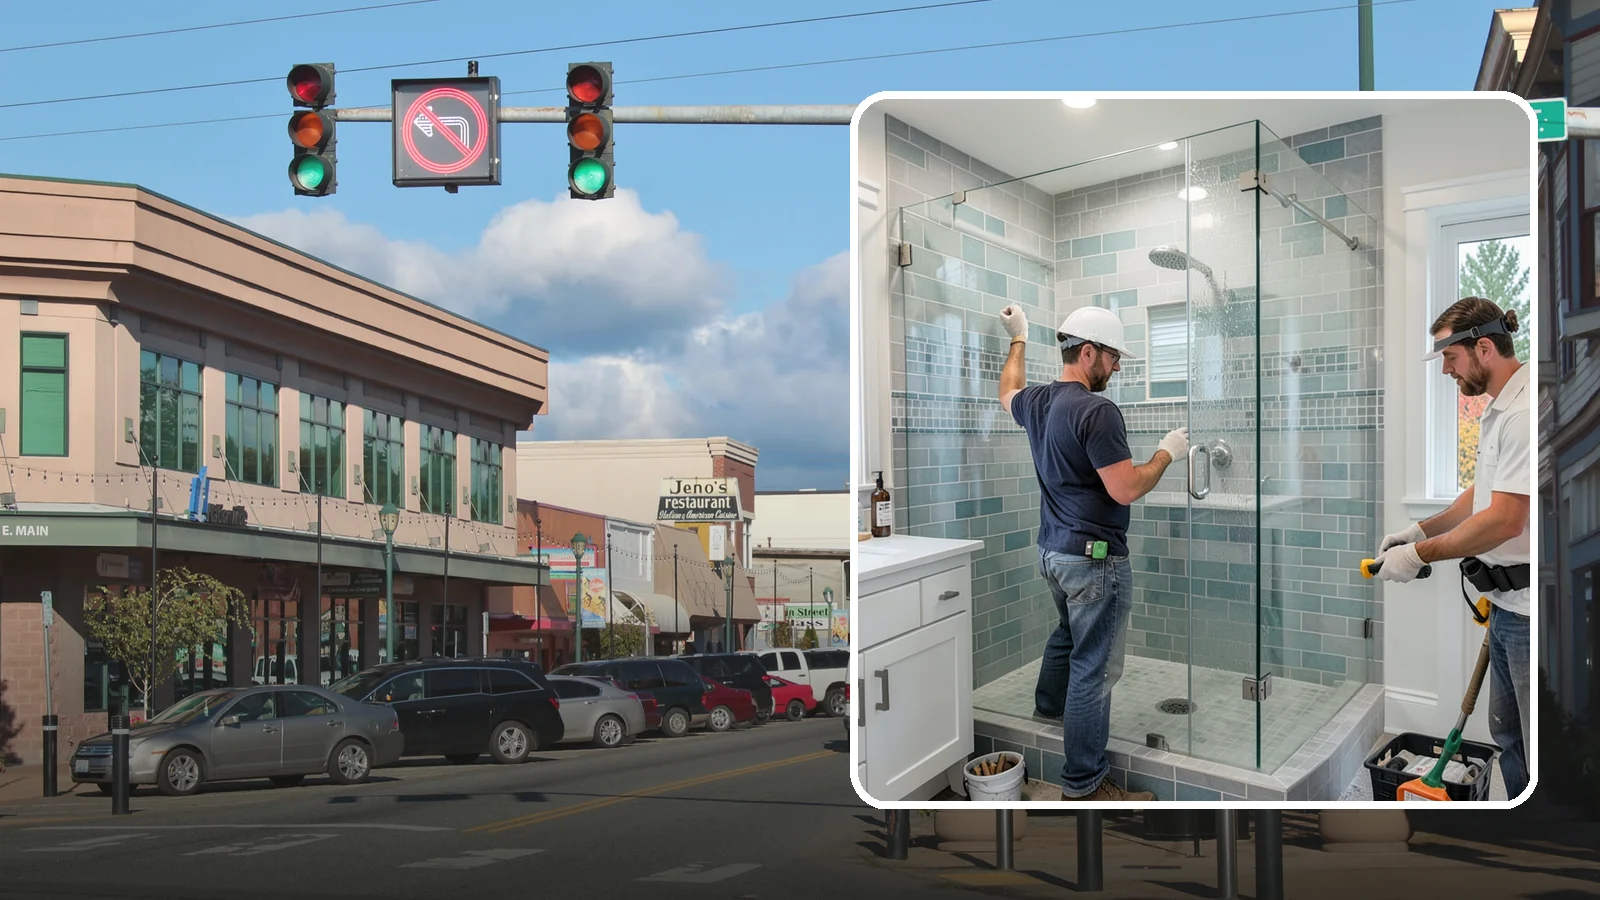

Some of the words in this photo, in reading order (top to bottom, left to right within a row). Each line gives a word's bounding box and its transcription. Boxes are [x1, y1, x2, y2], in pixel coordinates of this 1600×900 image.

[670, 480, 727, 495] Jeno's
[665, 496, 731, 509] restaurant
[658, 510, 681, 520] Italian
[686, 509, 715, 519] American
[715, 509, 738, 519] Cuisine
[2, 525, 13, 536] E.
[15, 525, 49, 537] MAIN
[797, 607, 829, 617] Street
[791, 619, 824, 627] lass
